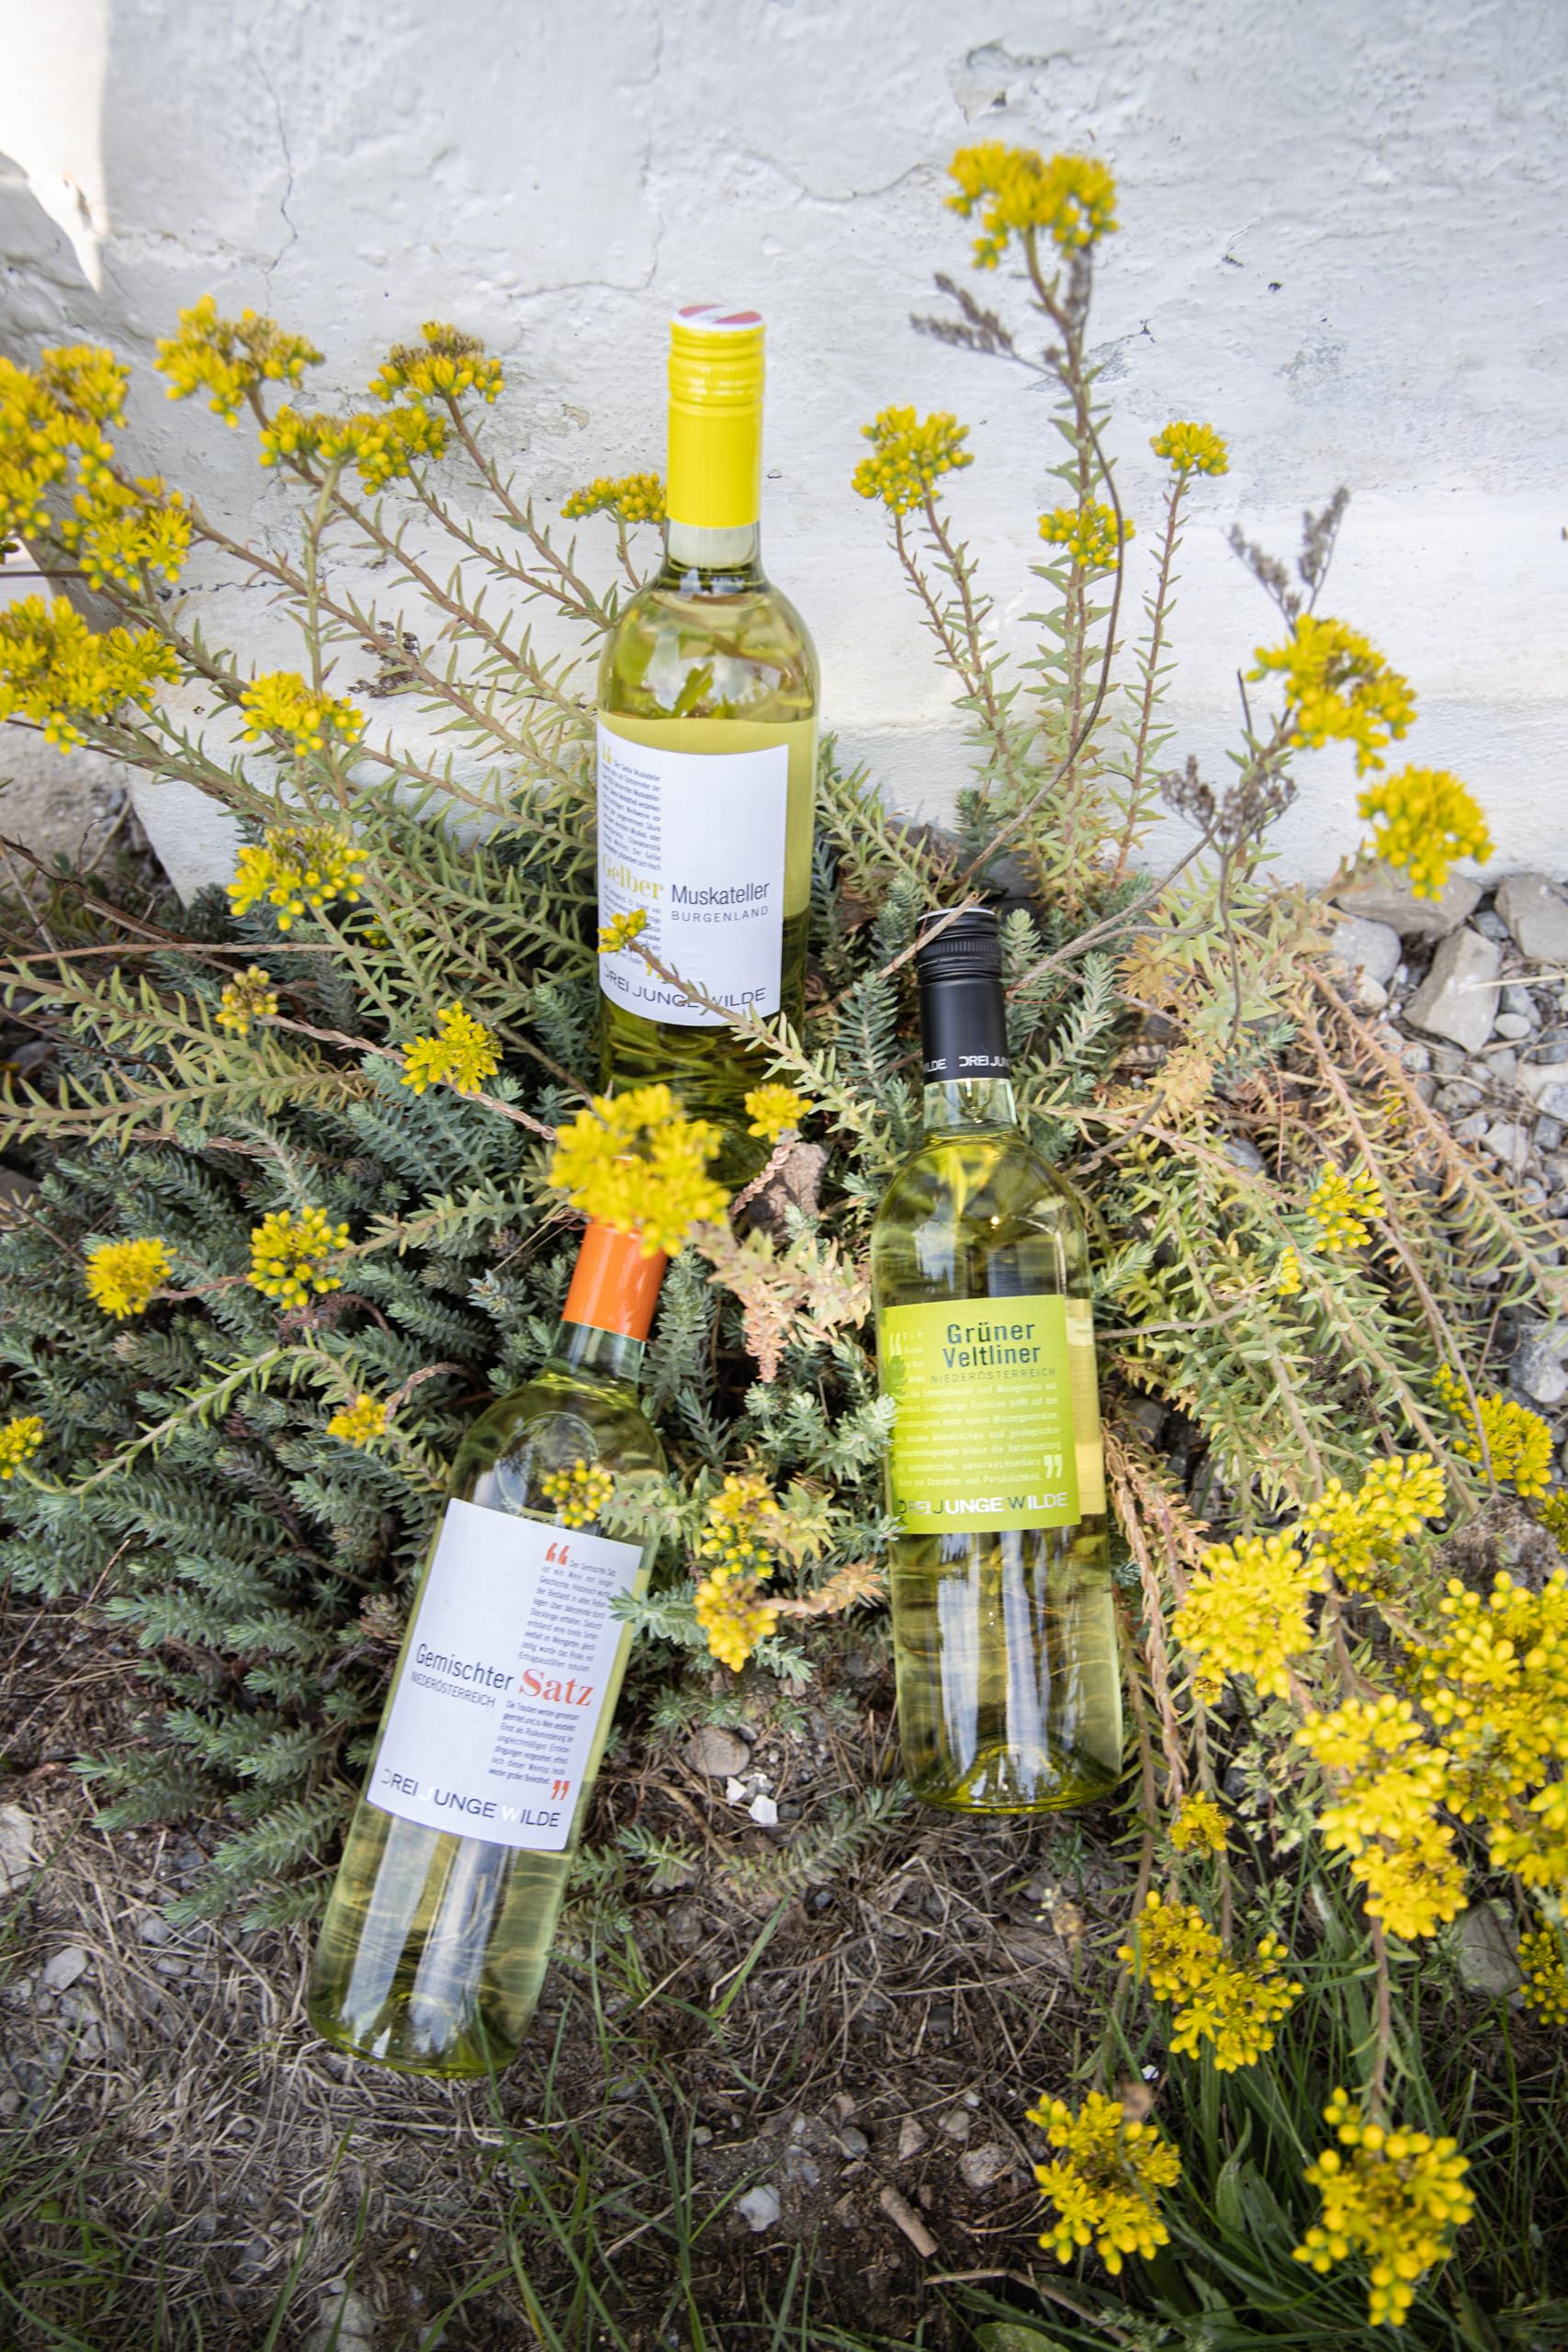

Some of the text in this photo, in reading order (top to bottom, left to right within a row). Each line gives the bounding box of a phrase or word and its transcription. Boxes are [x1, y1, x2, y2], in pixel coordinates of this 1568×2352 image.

[603, 853, 770, 906] Gelber Muskateller
[671, 906, 769, 922] BURGENLAND
[947, 1321, 1035, 1344] Grüner
[942, 1345, 1041, 1368] Veltliner
[931, 1368, 1056, 1383] NIEDERÖSTERREICH
[933, 1497, 1004, 1514] JUNGE
[1007, 1492, 1068, 1510] WILDE
[416, 1643, 594, 1707] Gemischter Satz
[418, 1785, 498, 1819] JUNGE
[502, 1804, 561, 1828] WILDE
